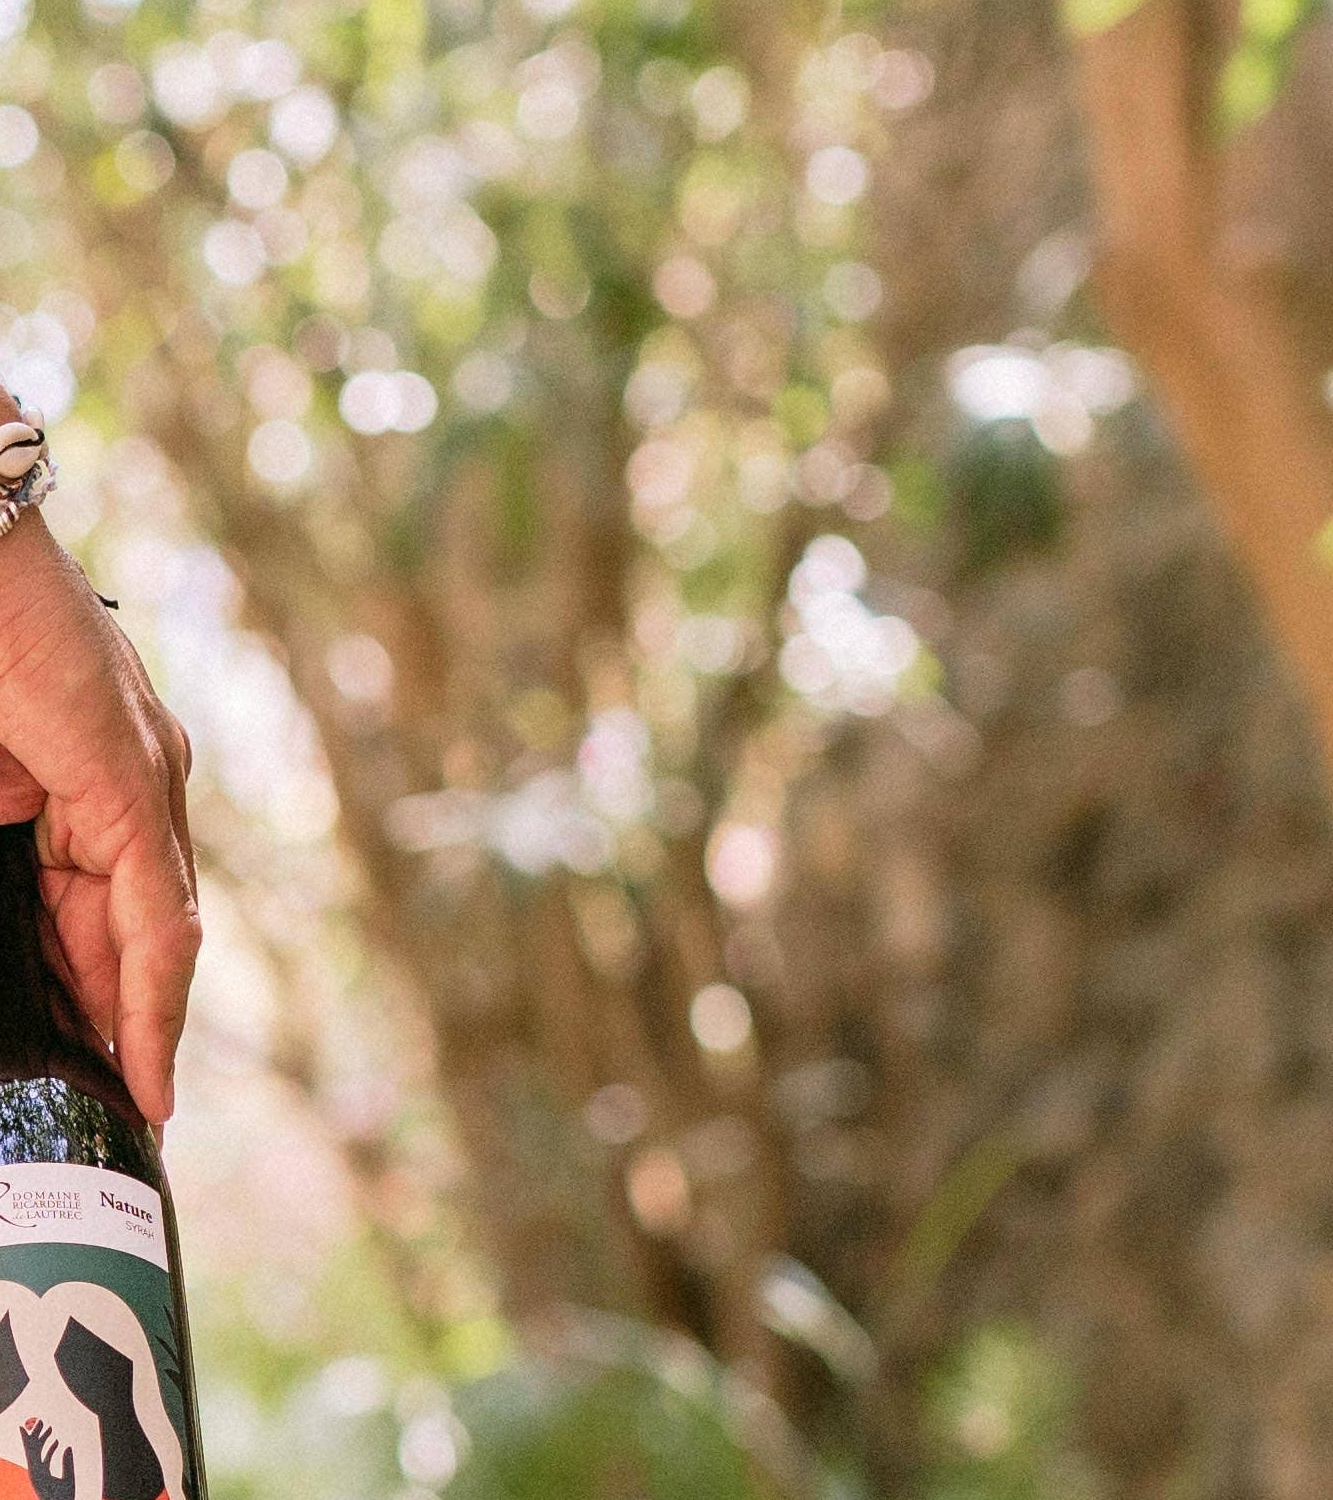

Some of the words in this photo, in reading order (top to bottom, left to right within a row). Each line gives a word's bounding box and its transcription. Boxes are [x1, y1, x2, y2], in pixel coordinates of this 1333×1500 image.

[12, 1191, 81, 1201] DOMAINE
[12, 1200, 82, 1210] RICARDELLE
[99, 1190, 153, 1223] Nature
[26, 1210, 83, 1220] LAUTREC
[125, 1220, 155, 1240] SYRAH
